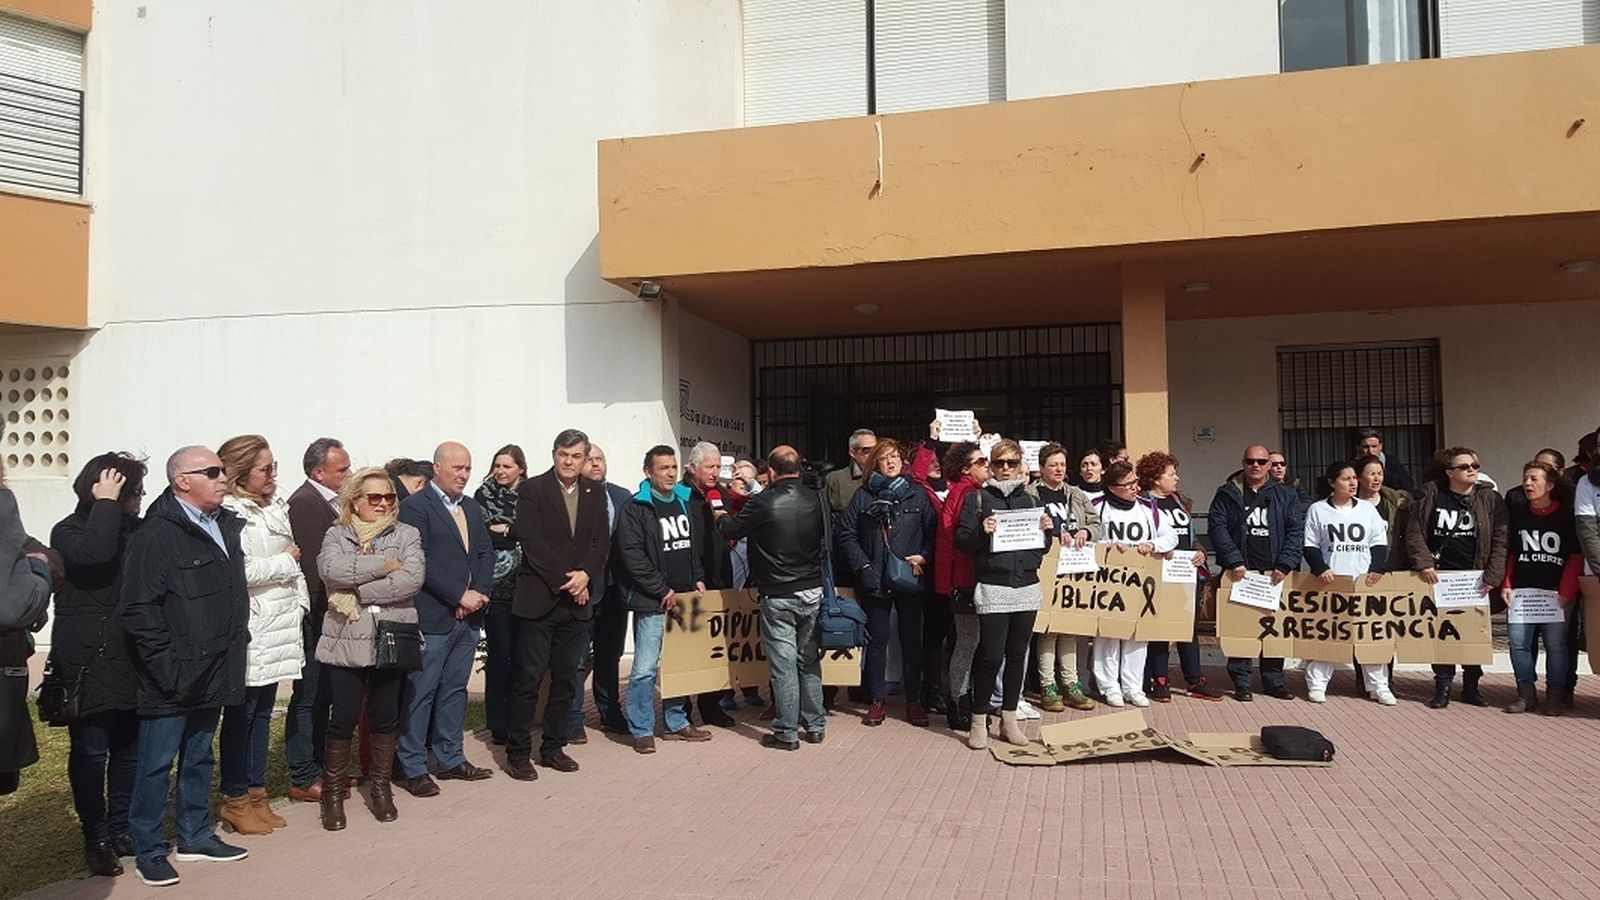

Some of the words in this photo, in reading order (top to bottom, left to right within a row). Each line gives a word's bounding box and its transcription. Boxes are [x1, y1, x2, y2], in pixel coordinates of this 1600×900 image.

[660, 514, 690, 541] NO
[1108, 521, 1143, 541] NO
[1327, 523, 1366, 542] NO
[1520, 529, 1561, 554] NO
